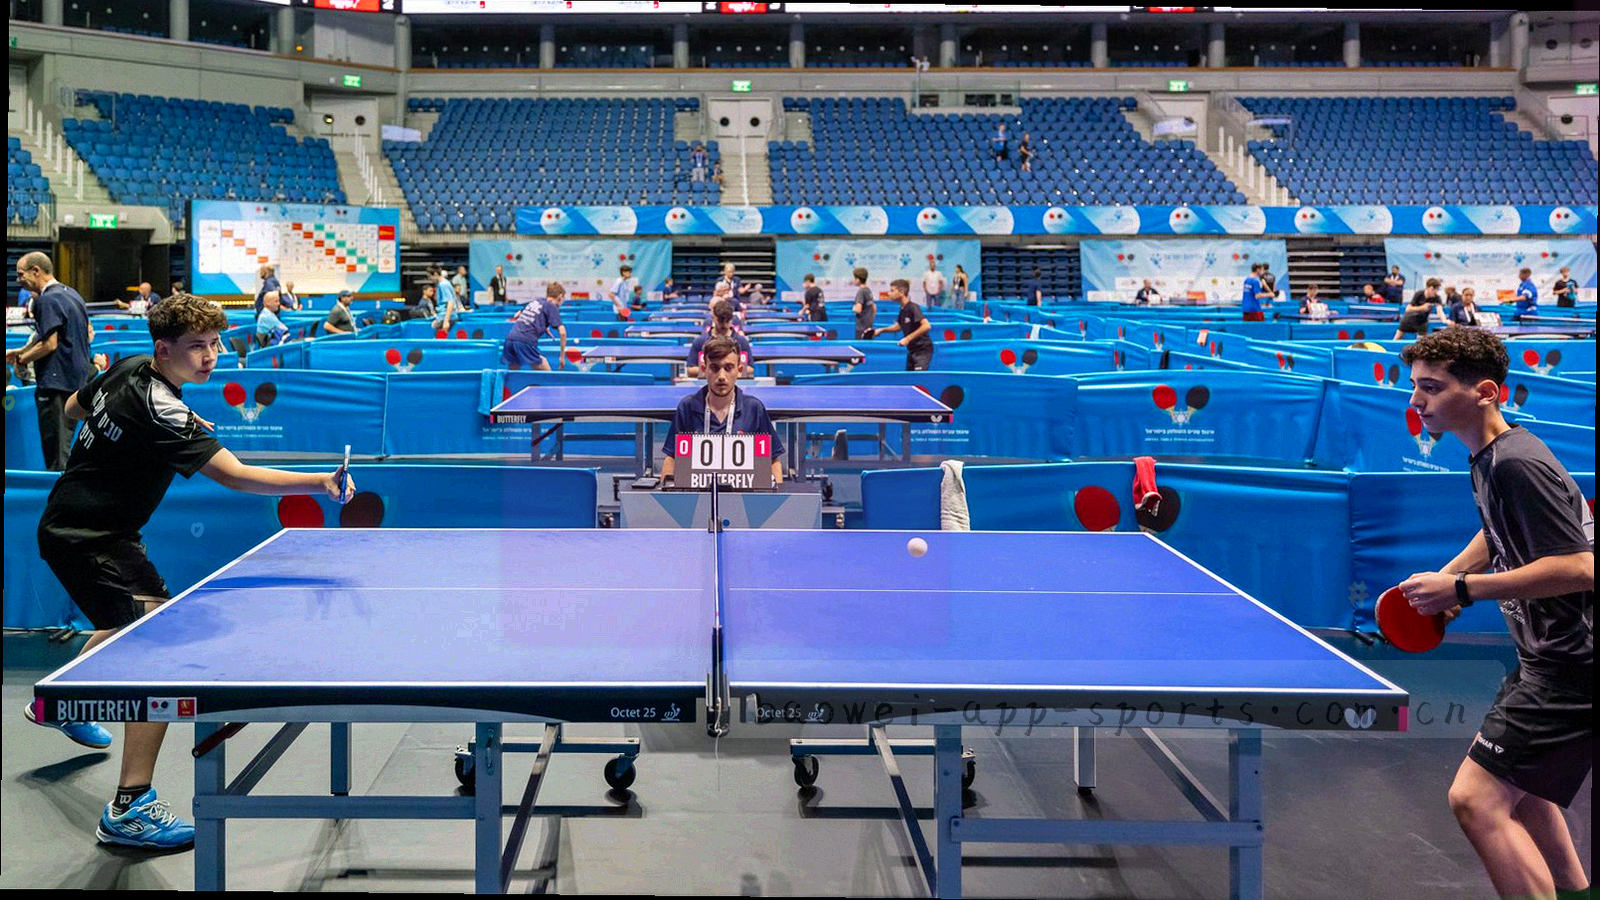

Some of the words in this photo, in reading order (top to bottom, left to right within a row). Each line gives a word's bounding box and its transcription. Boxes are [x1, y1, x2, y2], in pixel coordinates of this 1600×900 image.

[497, 415, 527, 424] BUTTERFLY
[679, 440, 689, 455] 0
[701, 439, 713, 467] 0
[732, 439, 745, 467] 0
[759, 440, 766, 455] 1
[57, 700, 141, 721] BUTTERFLY
[610, 707, 641, 718] Octet
[643, 707, 656, 718] 25
[756, 707, 785, 718] Octet
[787, 707, 801, 718] 25
